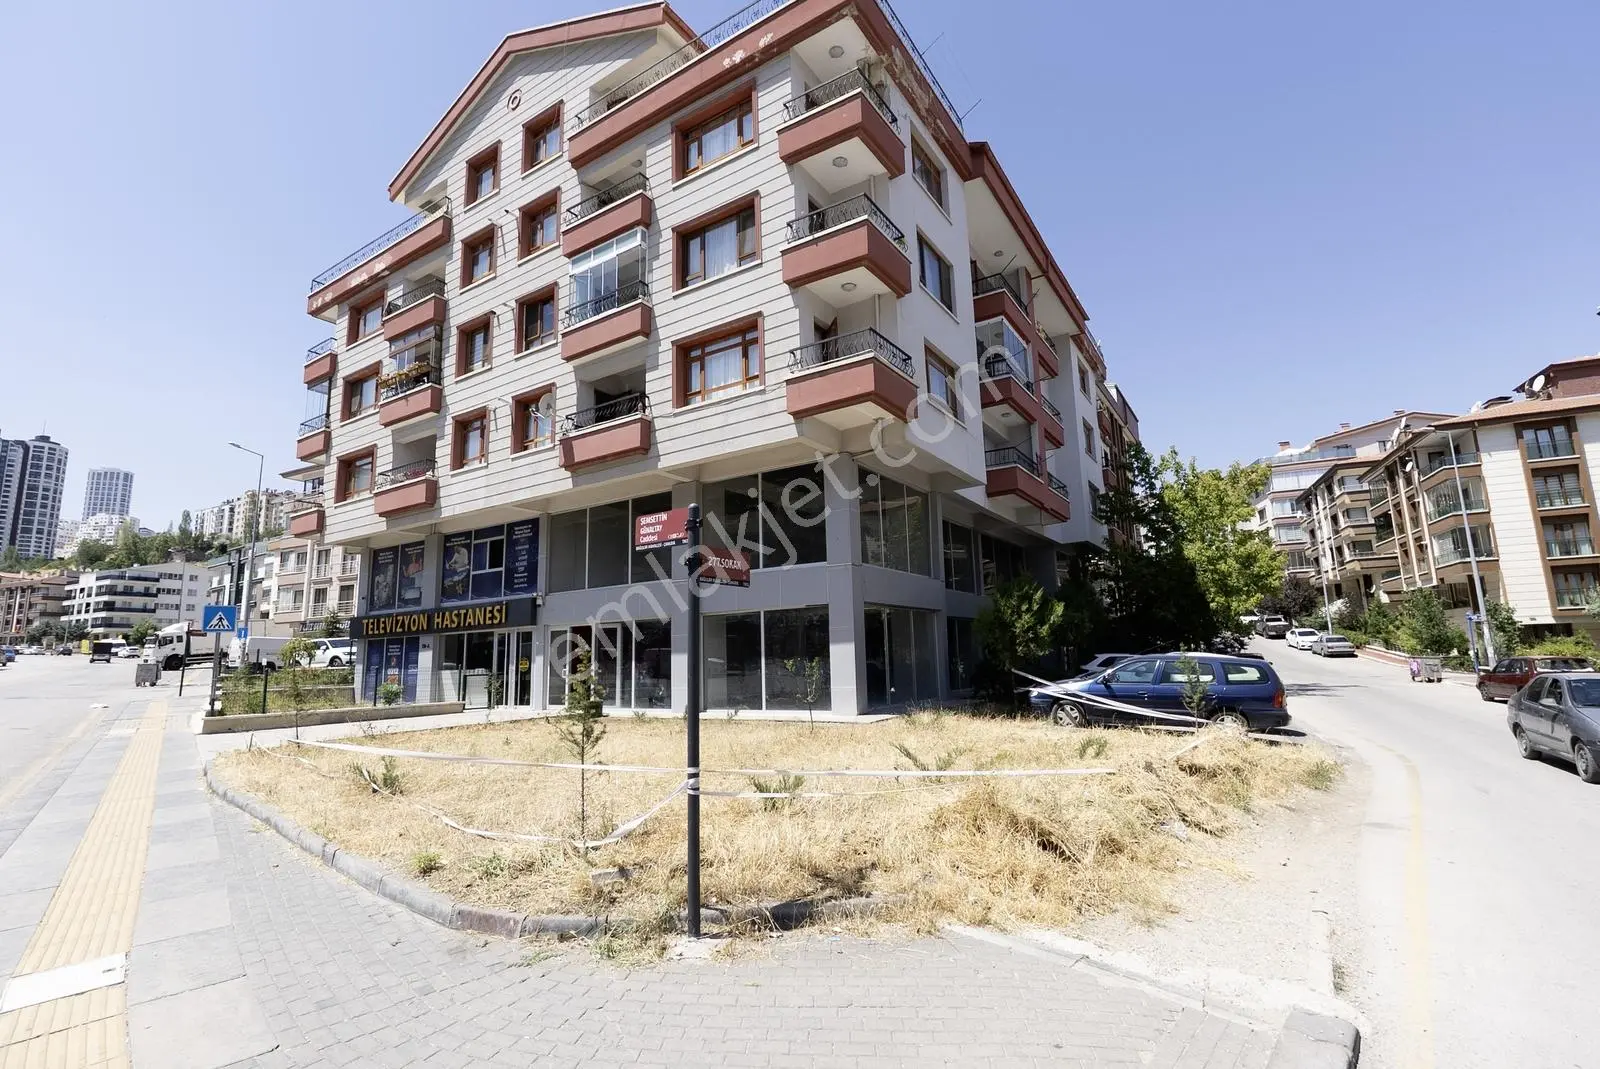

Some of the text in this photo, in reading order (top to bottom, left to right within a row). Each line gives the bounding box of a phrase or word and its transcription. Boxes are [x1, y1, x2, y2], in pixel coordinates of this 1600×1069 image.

[640, 534, 658, 543] Caddesi
[362, 613, 428, 636] TELEVİZYON
[434, 601, 507, 630] HASTANESİ
